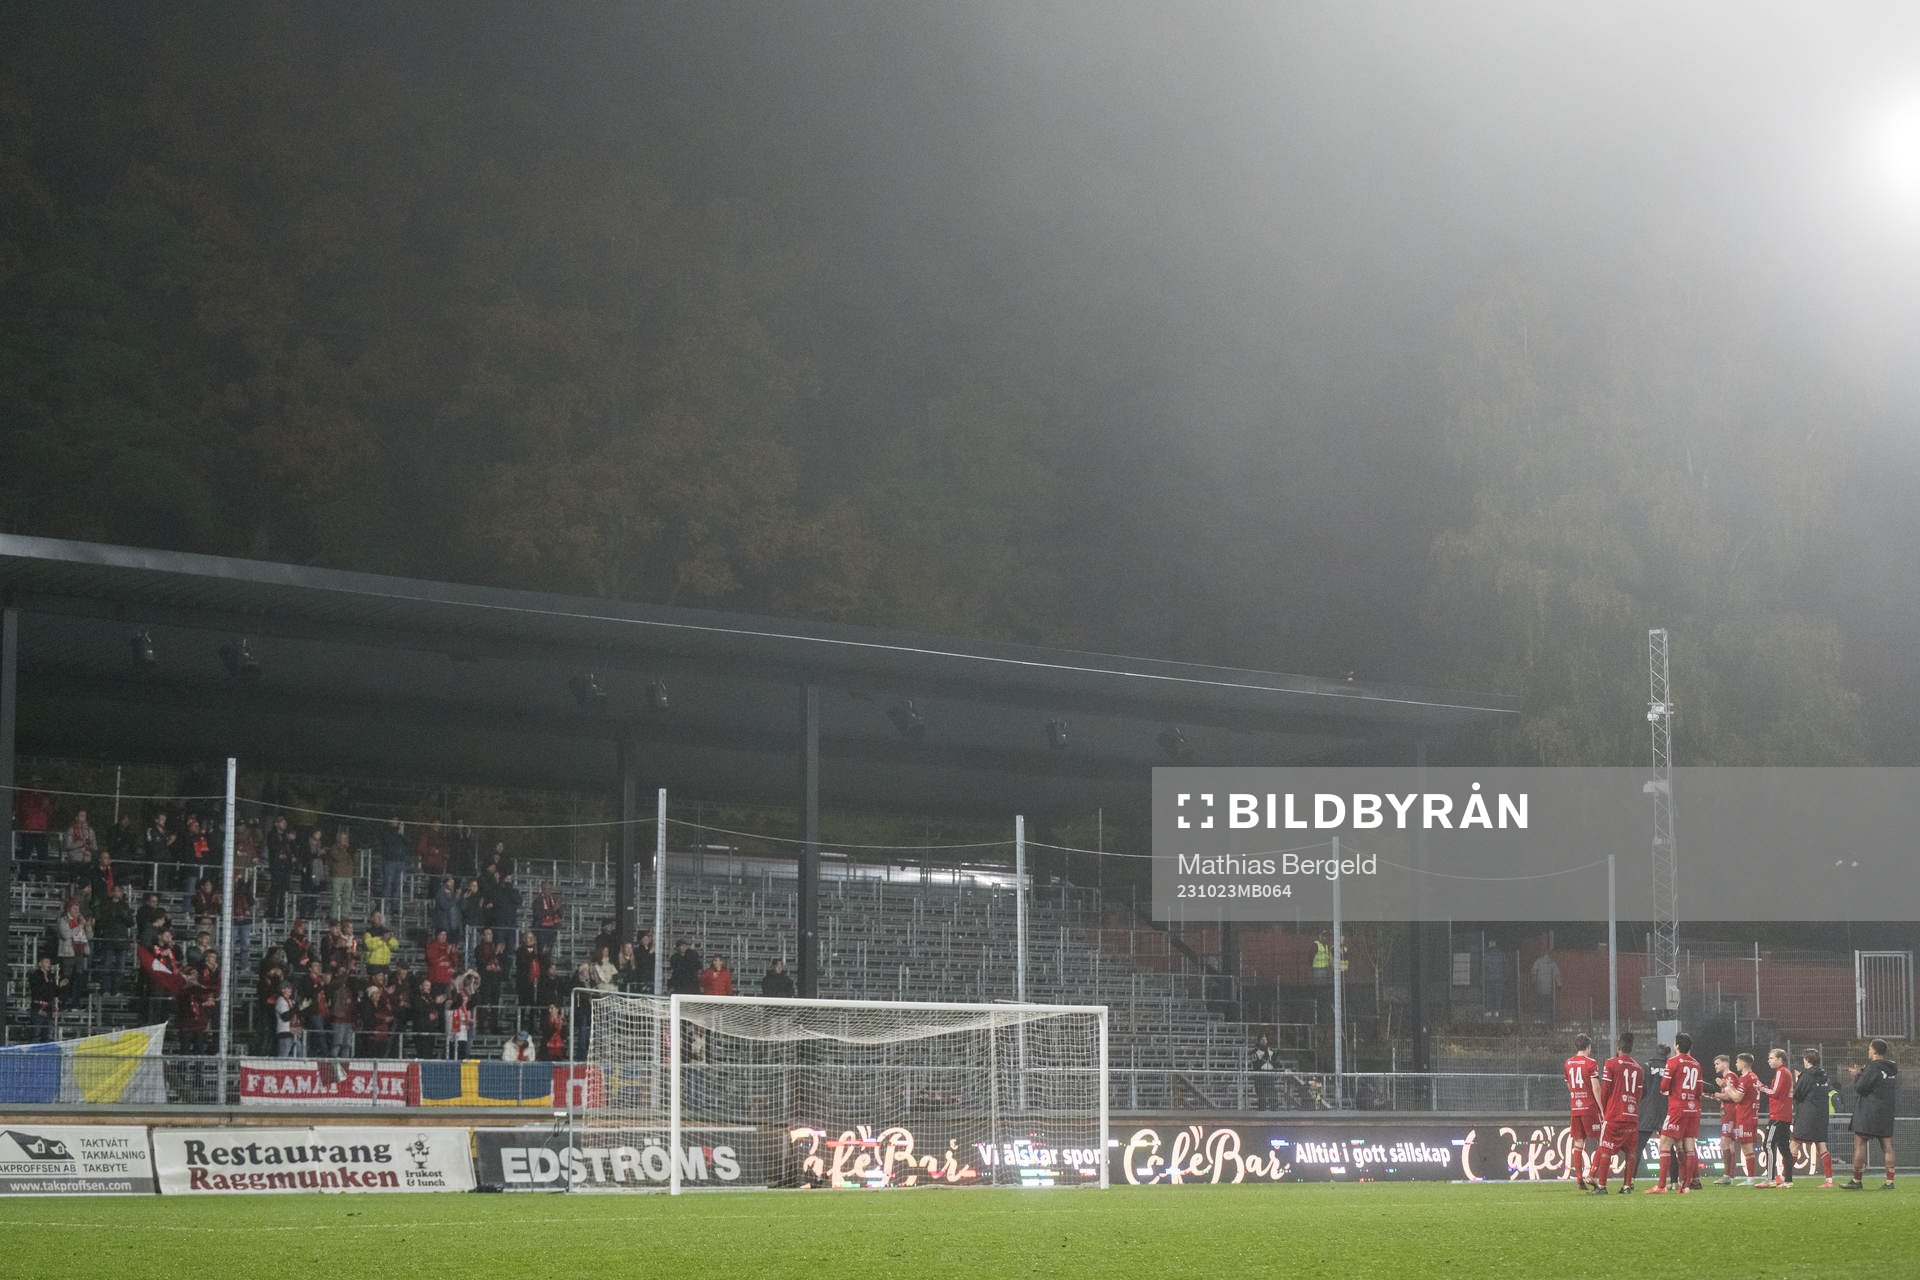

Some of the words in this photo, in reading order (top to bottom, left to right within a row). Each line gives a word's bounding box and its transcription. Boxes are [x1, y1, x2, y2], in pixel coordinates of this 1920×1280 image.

[1568, 1066, 1584, 1089] 14
[1623, 1068, 1638, 1094] 11
[1682, 1066, 1699, 1091] 20
[184, 1139, 393, 1166] Restaurang
[1063, 1148, 1103, 1170] spor
[1295, 1142, 1340, 1164] Alltid
[1341, 1142, 1350, 1163] i
[1353, 1144, 1388, 1168] gott
[1389, 1142, 1451, 1167] sällskap
[63, 1164, 77, 1173] AB
[83, 1163, 129, 1172] TAKBYTE
[188, 1166, 400, 1191] Raggmunken
[10, 1180, 132, 1192] www.takproffsen.com
[417, 1179, 446, 1187] lunch
